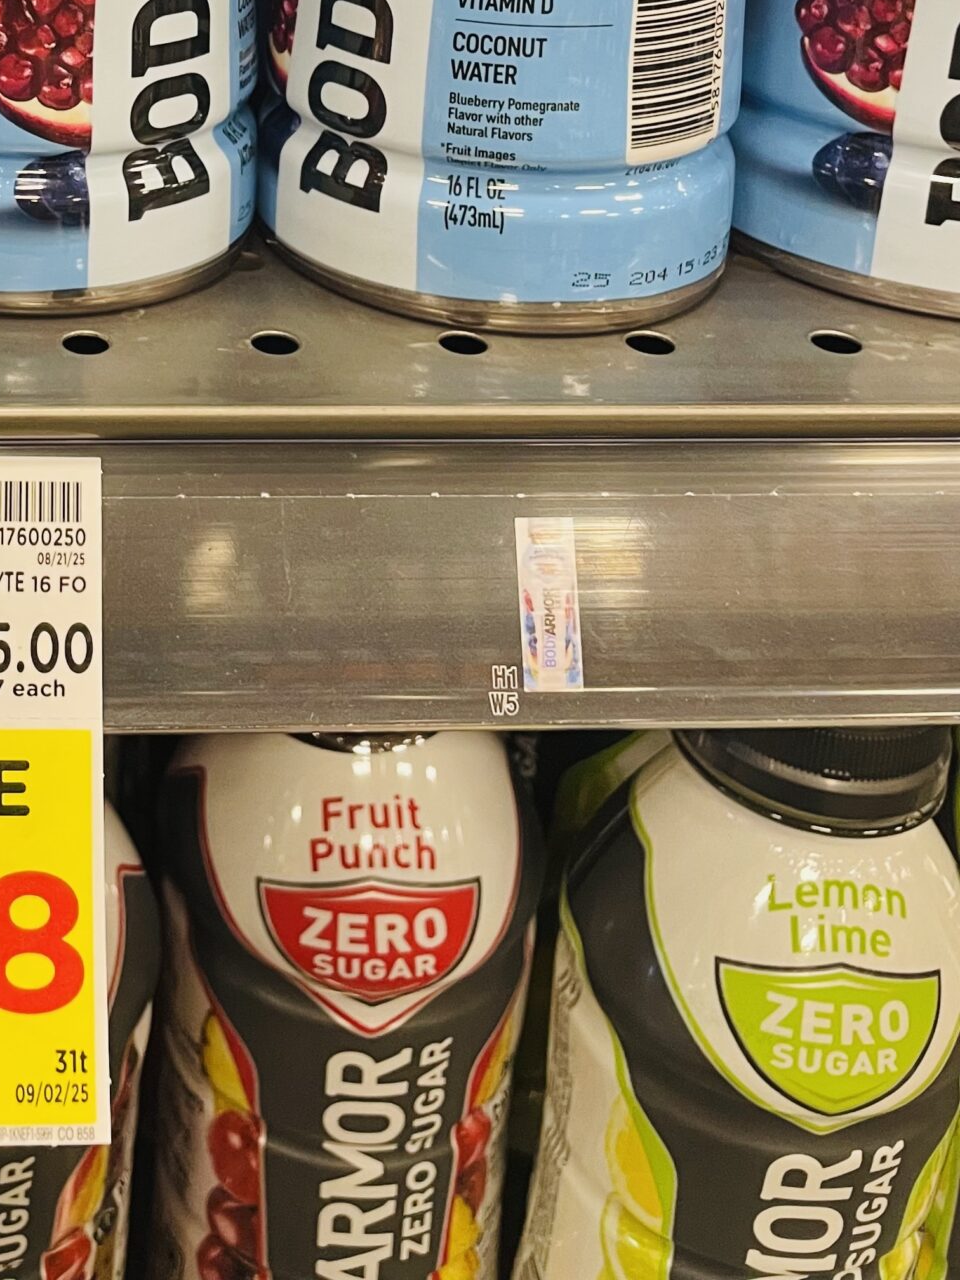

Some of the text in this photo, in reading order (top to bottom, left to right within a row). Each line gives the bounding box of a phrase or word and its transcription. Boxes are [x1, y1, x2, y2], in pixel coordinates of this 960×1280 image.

[452, 31, 548, 58] COCONUT
[450, 58, 518, 85] WATER
[449, 91, 580, 114] Blueberry Pomegranate
[448, 107, 544, 127] Flavor with other
[447, 122, 533, 142] Natural Flavors
[474, 146, 516, 162] Images
[447, 174, 482, 199] 16 FL
[444, 200, 505, 235] (473mL)
[571, 267, 668, 288] 25 204
[36, 552, 85, 566] 08/21/25
[31, 576, 51, 593] 16
[59, 576, 87, 593] FO
[12, 679, 66, 697] each
[491, 665, 518, 689] H1
[489, 691, 519, 715] W5
[321, 794, 421, 832] Fruit
[309, 835, 437, 873] Punch
[766, 874, 907, 919] Lemon
[297, 905, 449, 955] ZERO
[790, 914, 892, 958] Lime
[312, 952, 438, 980] SUGAR
[758, 991, 909, 1046] ZERO
[55, 1049, 89, 1074] 31t
[770, 1043, 898, 1077] SUGAR
[15, 1080, 89, 1107] 09/02/25
[400, 1036, 453, 1262] ZERO SUGAR
[848, 1138, 905, 1269] SUGAR
